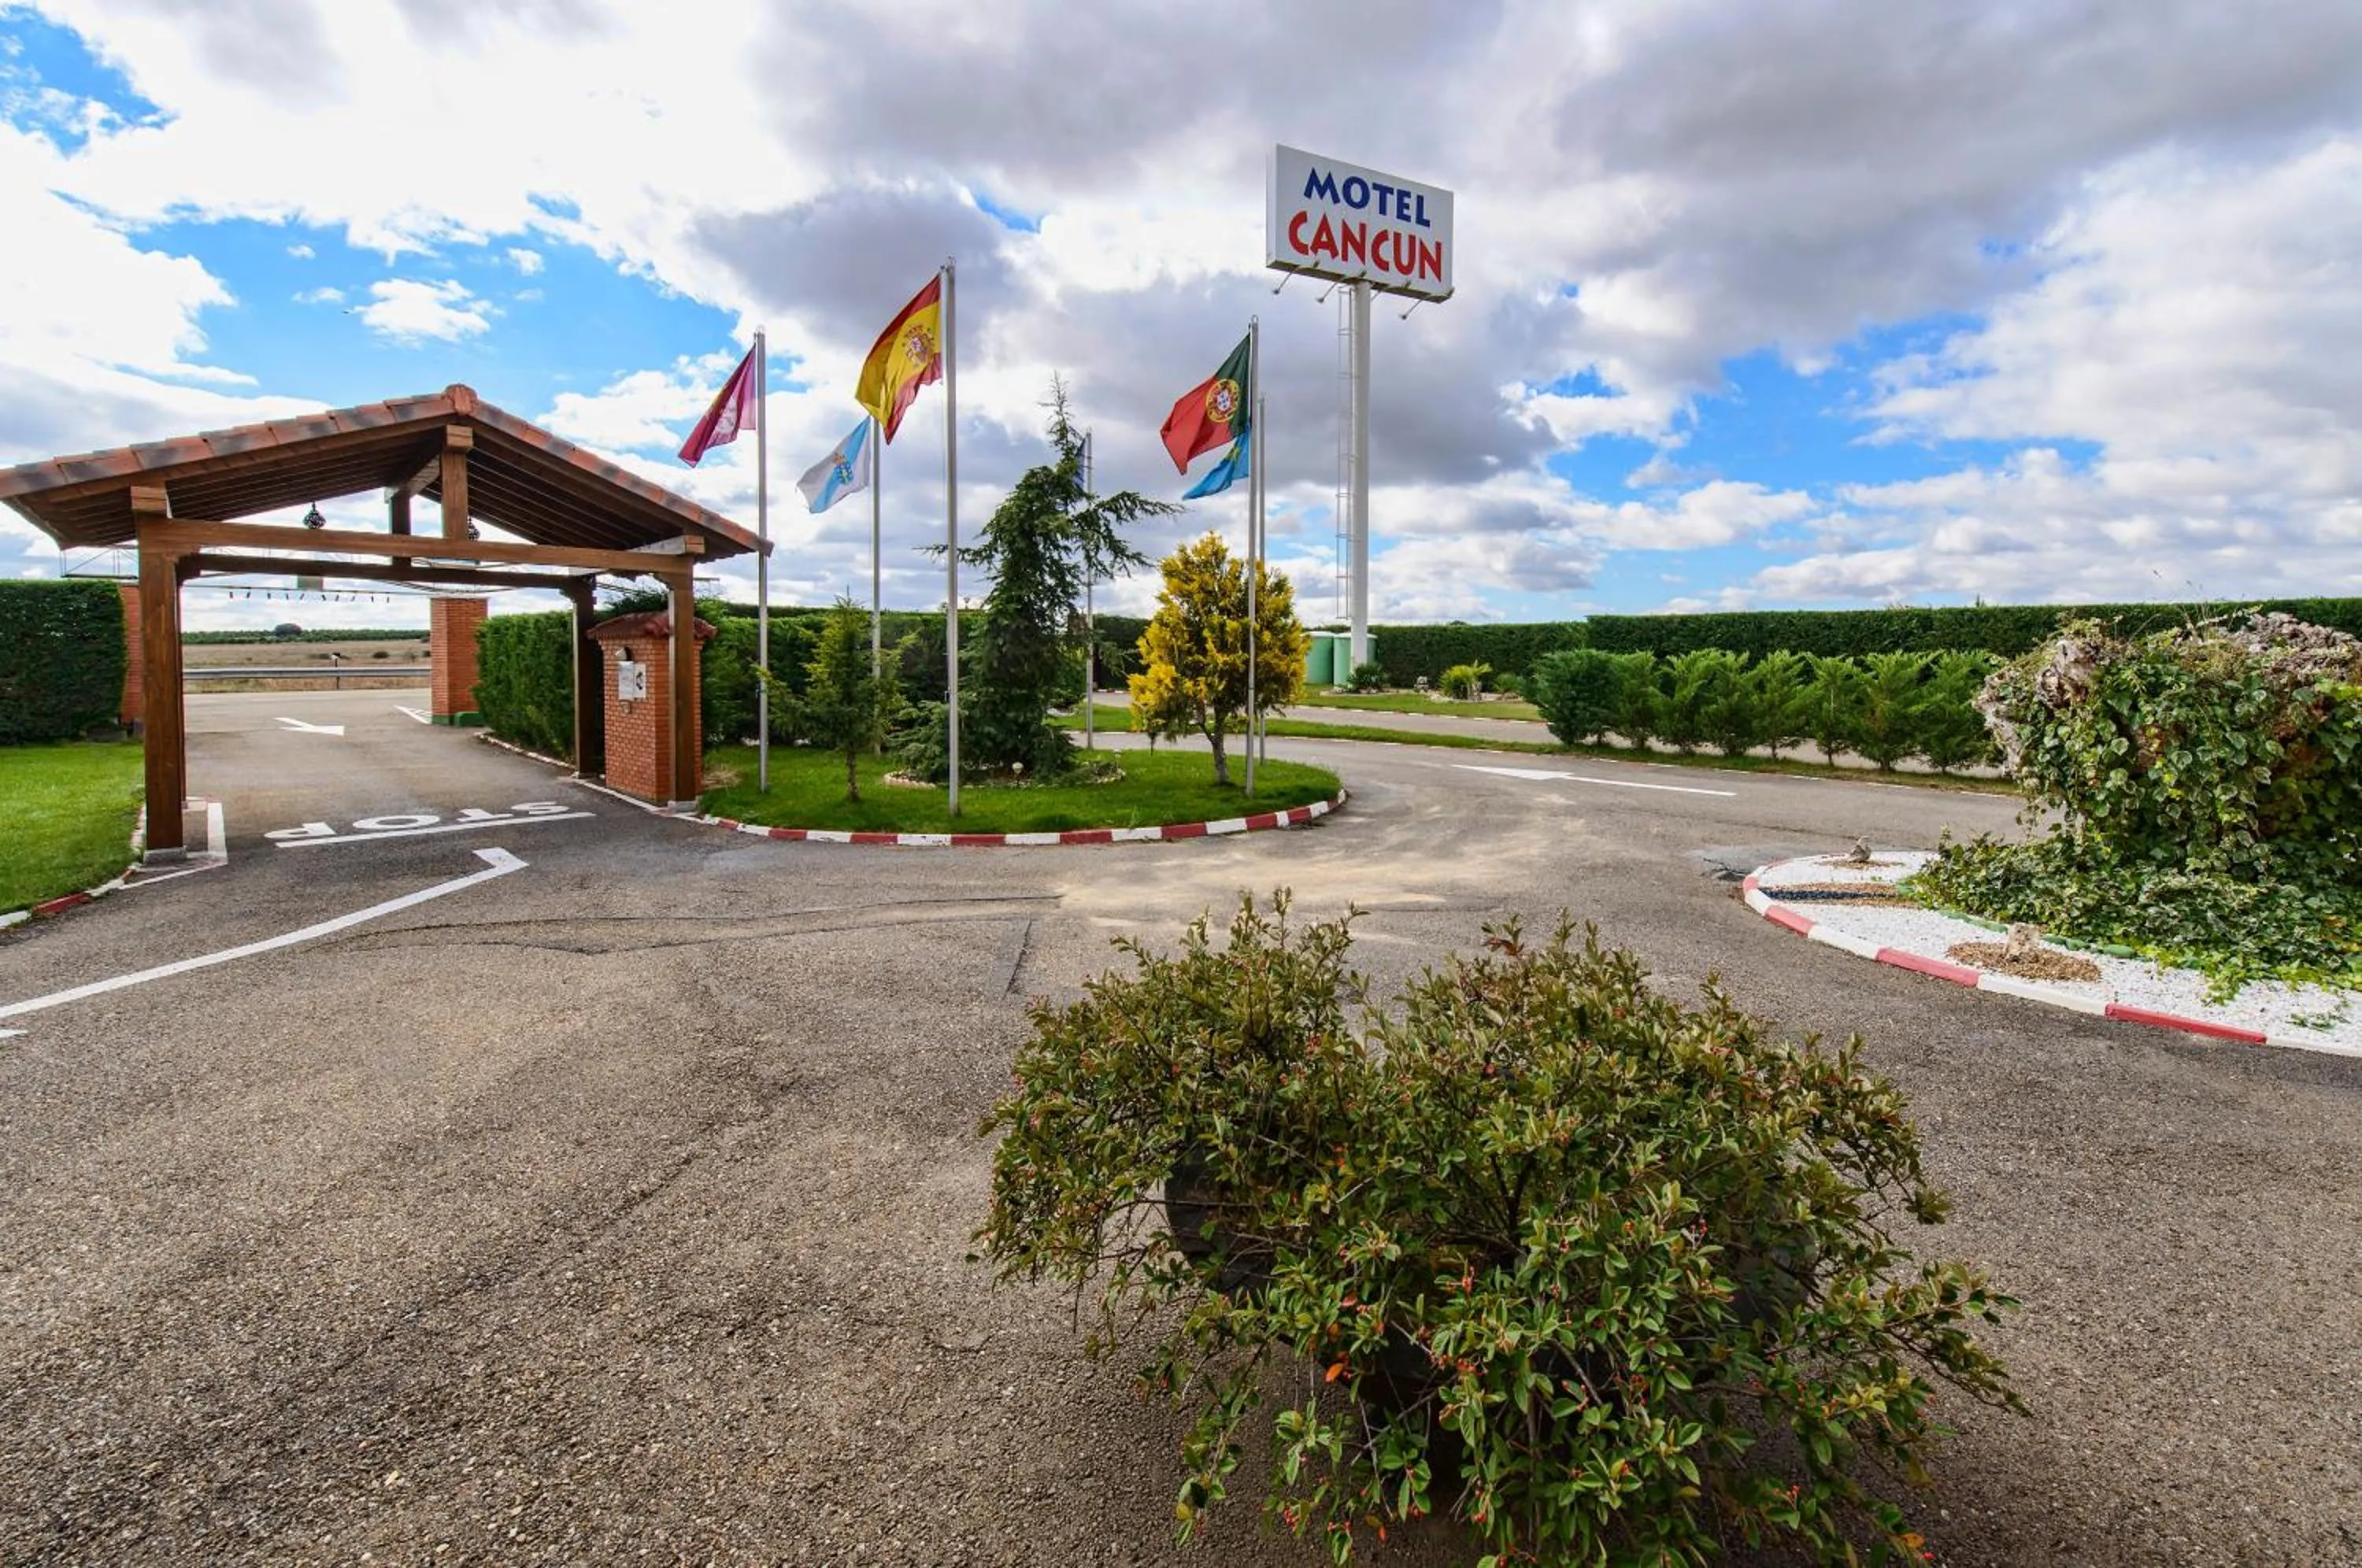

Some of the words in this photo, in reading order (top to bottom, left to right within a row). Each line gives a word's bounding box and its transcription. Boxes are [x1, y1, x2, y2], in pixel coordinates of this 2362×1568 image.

[1303, 167, 1431, 228] MOTEL
[1288, 209, 1442, 283] CANCUN
[264, 801, 570, 839] STOP
